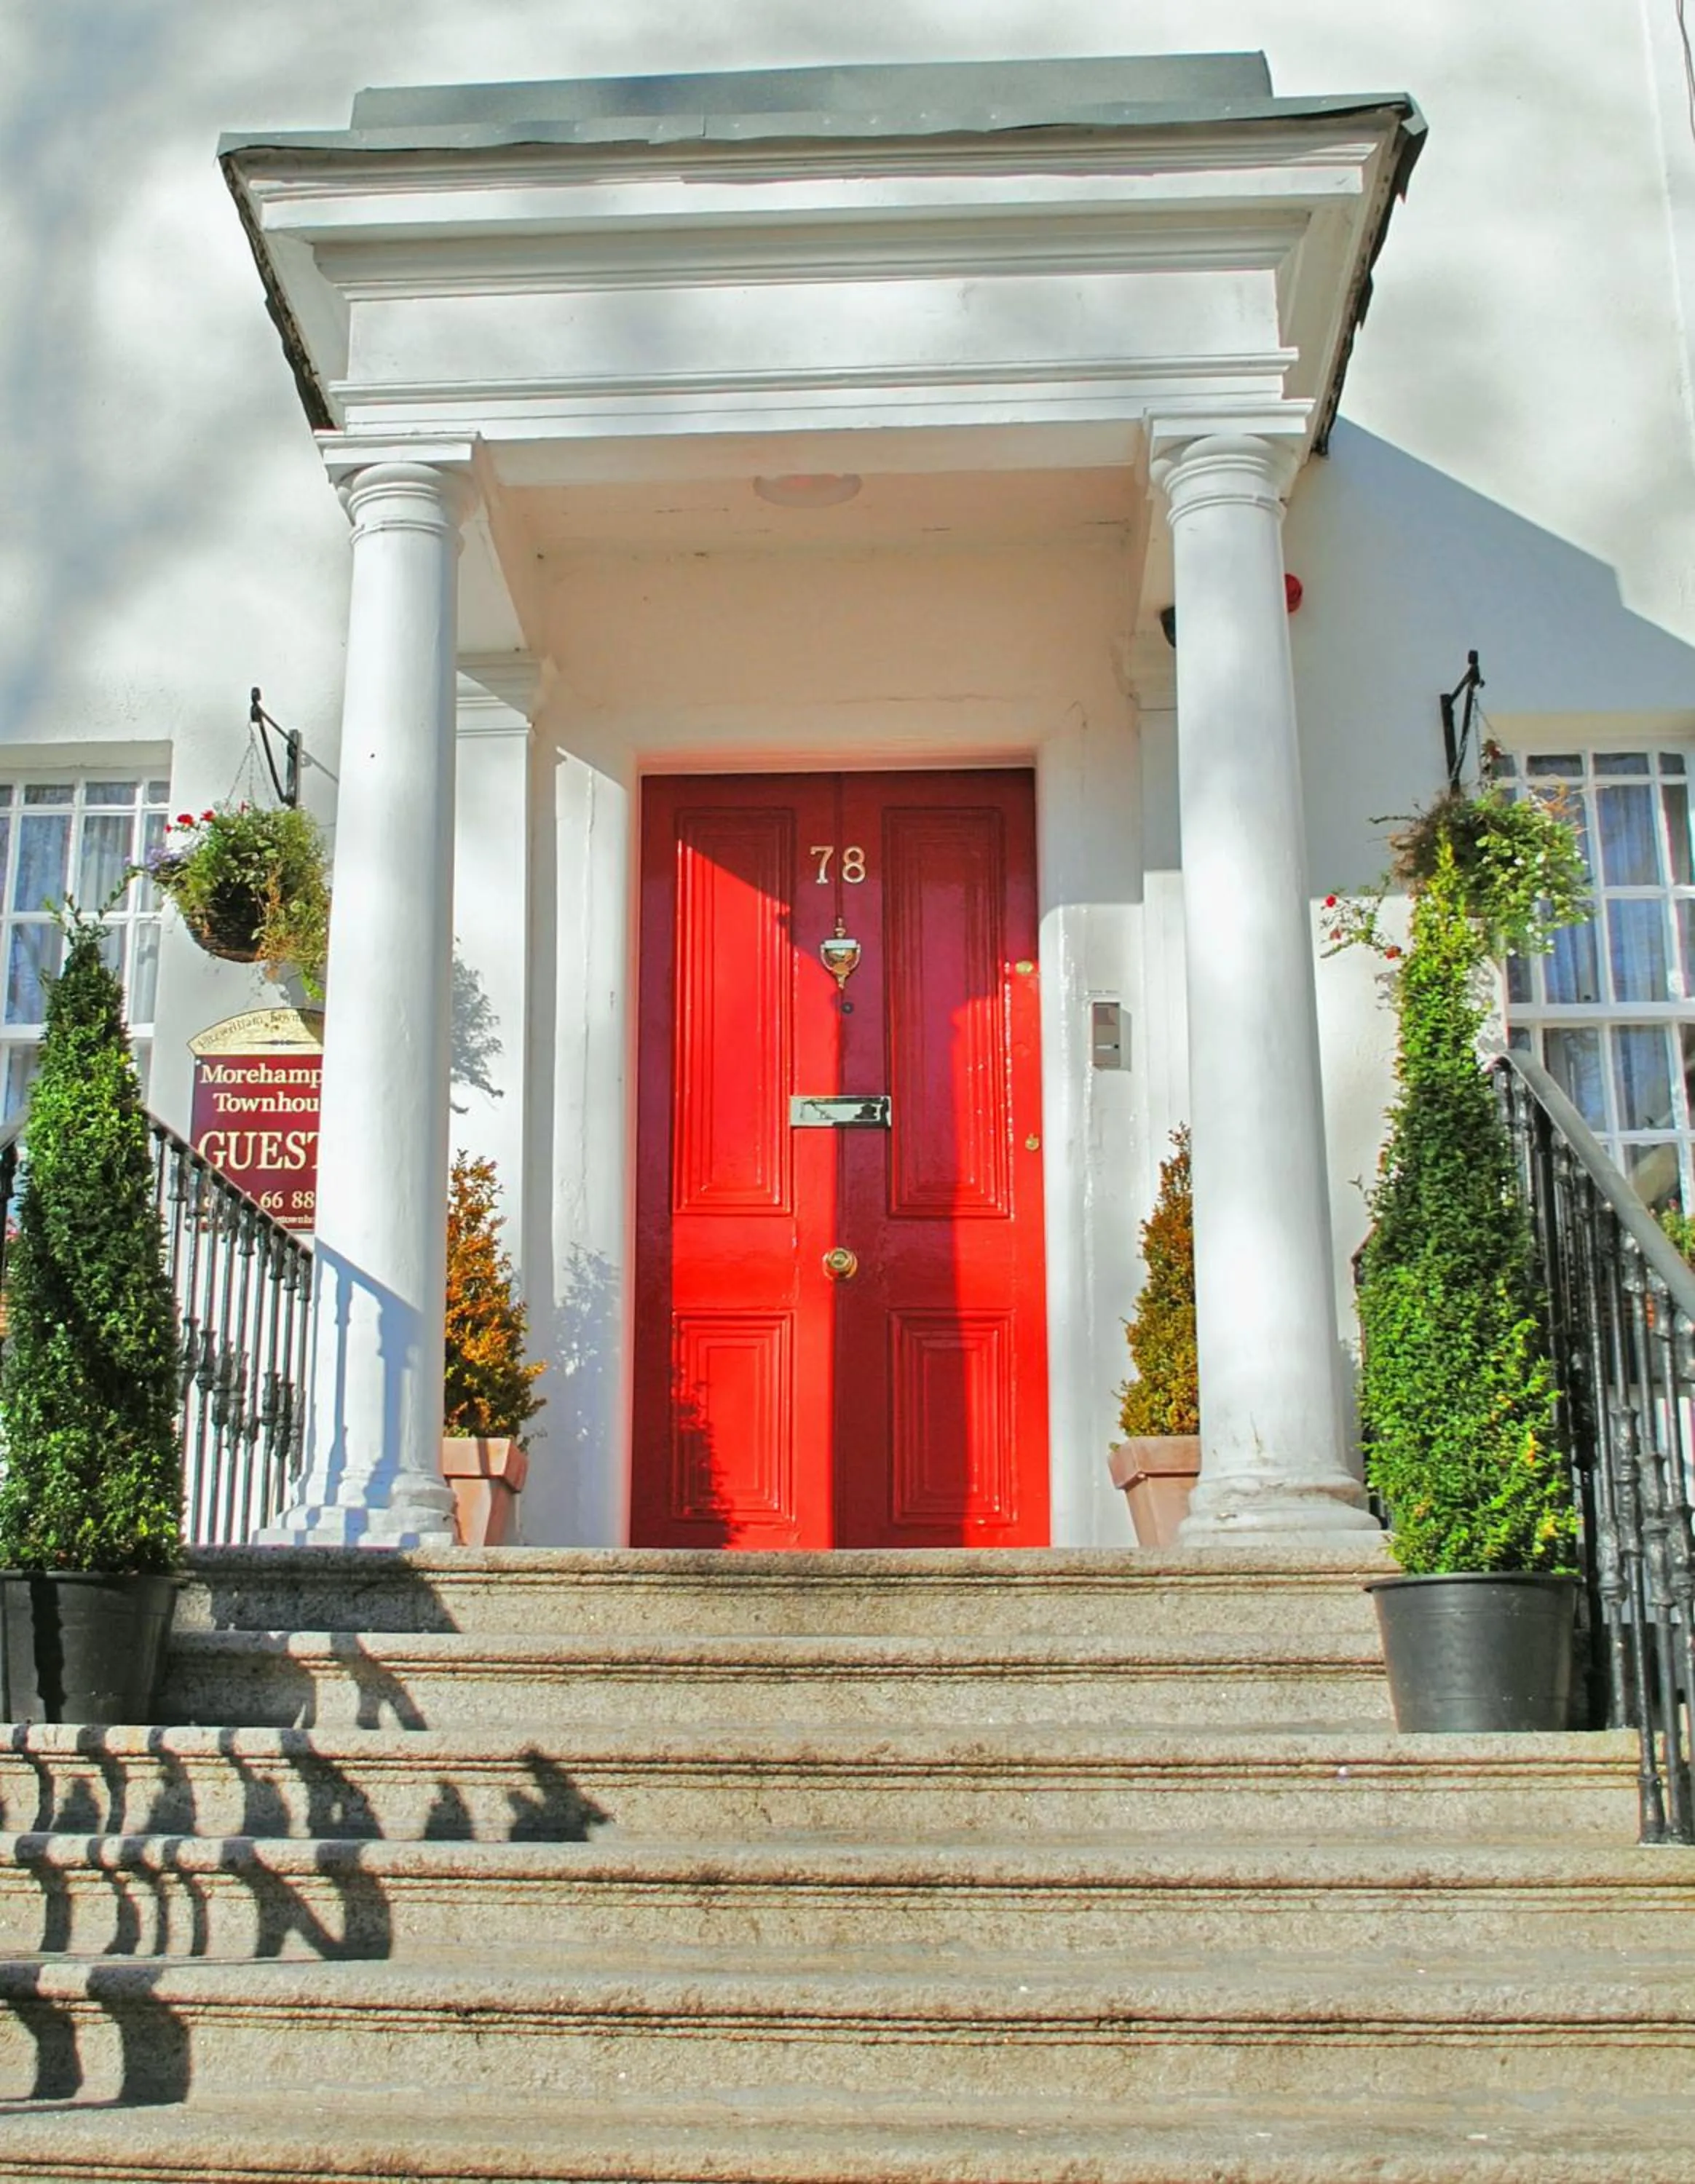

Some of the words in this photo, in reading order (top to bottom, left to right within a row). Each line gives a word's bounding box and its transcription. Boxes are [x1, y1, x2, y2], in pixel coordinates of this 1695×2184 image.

[810, 845, 866, 885] 78
[213, 1091, 319, 1112] Townhou
[260, 1190, 284, 1208] 66
[291, 1190, 315, 1208] 88
